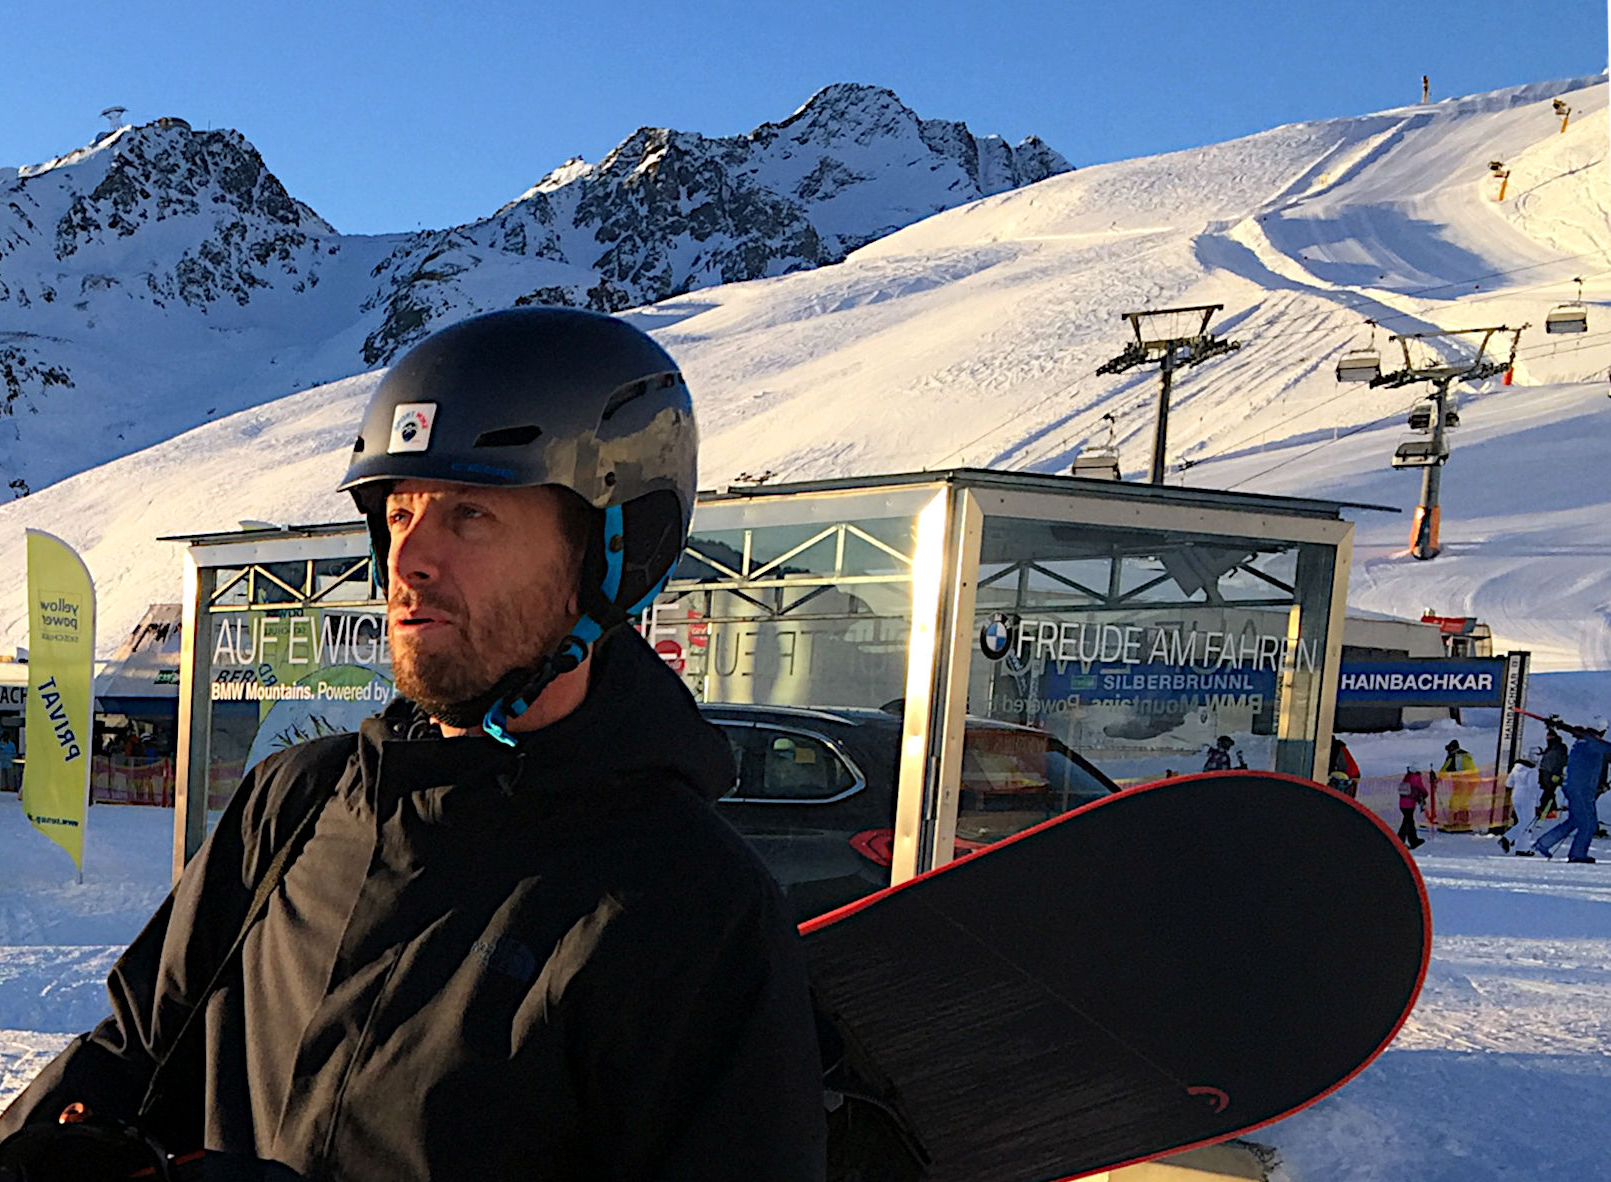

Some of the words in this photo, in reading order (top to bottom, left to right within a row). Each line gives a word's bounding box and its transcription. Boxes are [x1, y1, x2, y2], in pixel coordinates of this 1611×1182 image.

[212, 616, 280, 665] AUF
[1016, 620, 1143, 665] FREUDE
[1147, 627, 1198, 667] AM
[1203, 631, 1318, 674] FAHREN
[211, 682, 244, 700] BMW
[246, 681, 315, 701] Mountains.
[317, 681, 372, 701] Powered
[373, 681, 390, 704] by
[1103, 674, 1254, 690] SILBERBRUNNL
[1340, 673, 1493, 691] HAINBACHKAR
